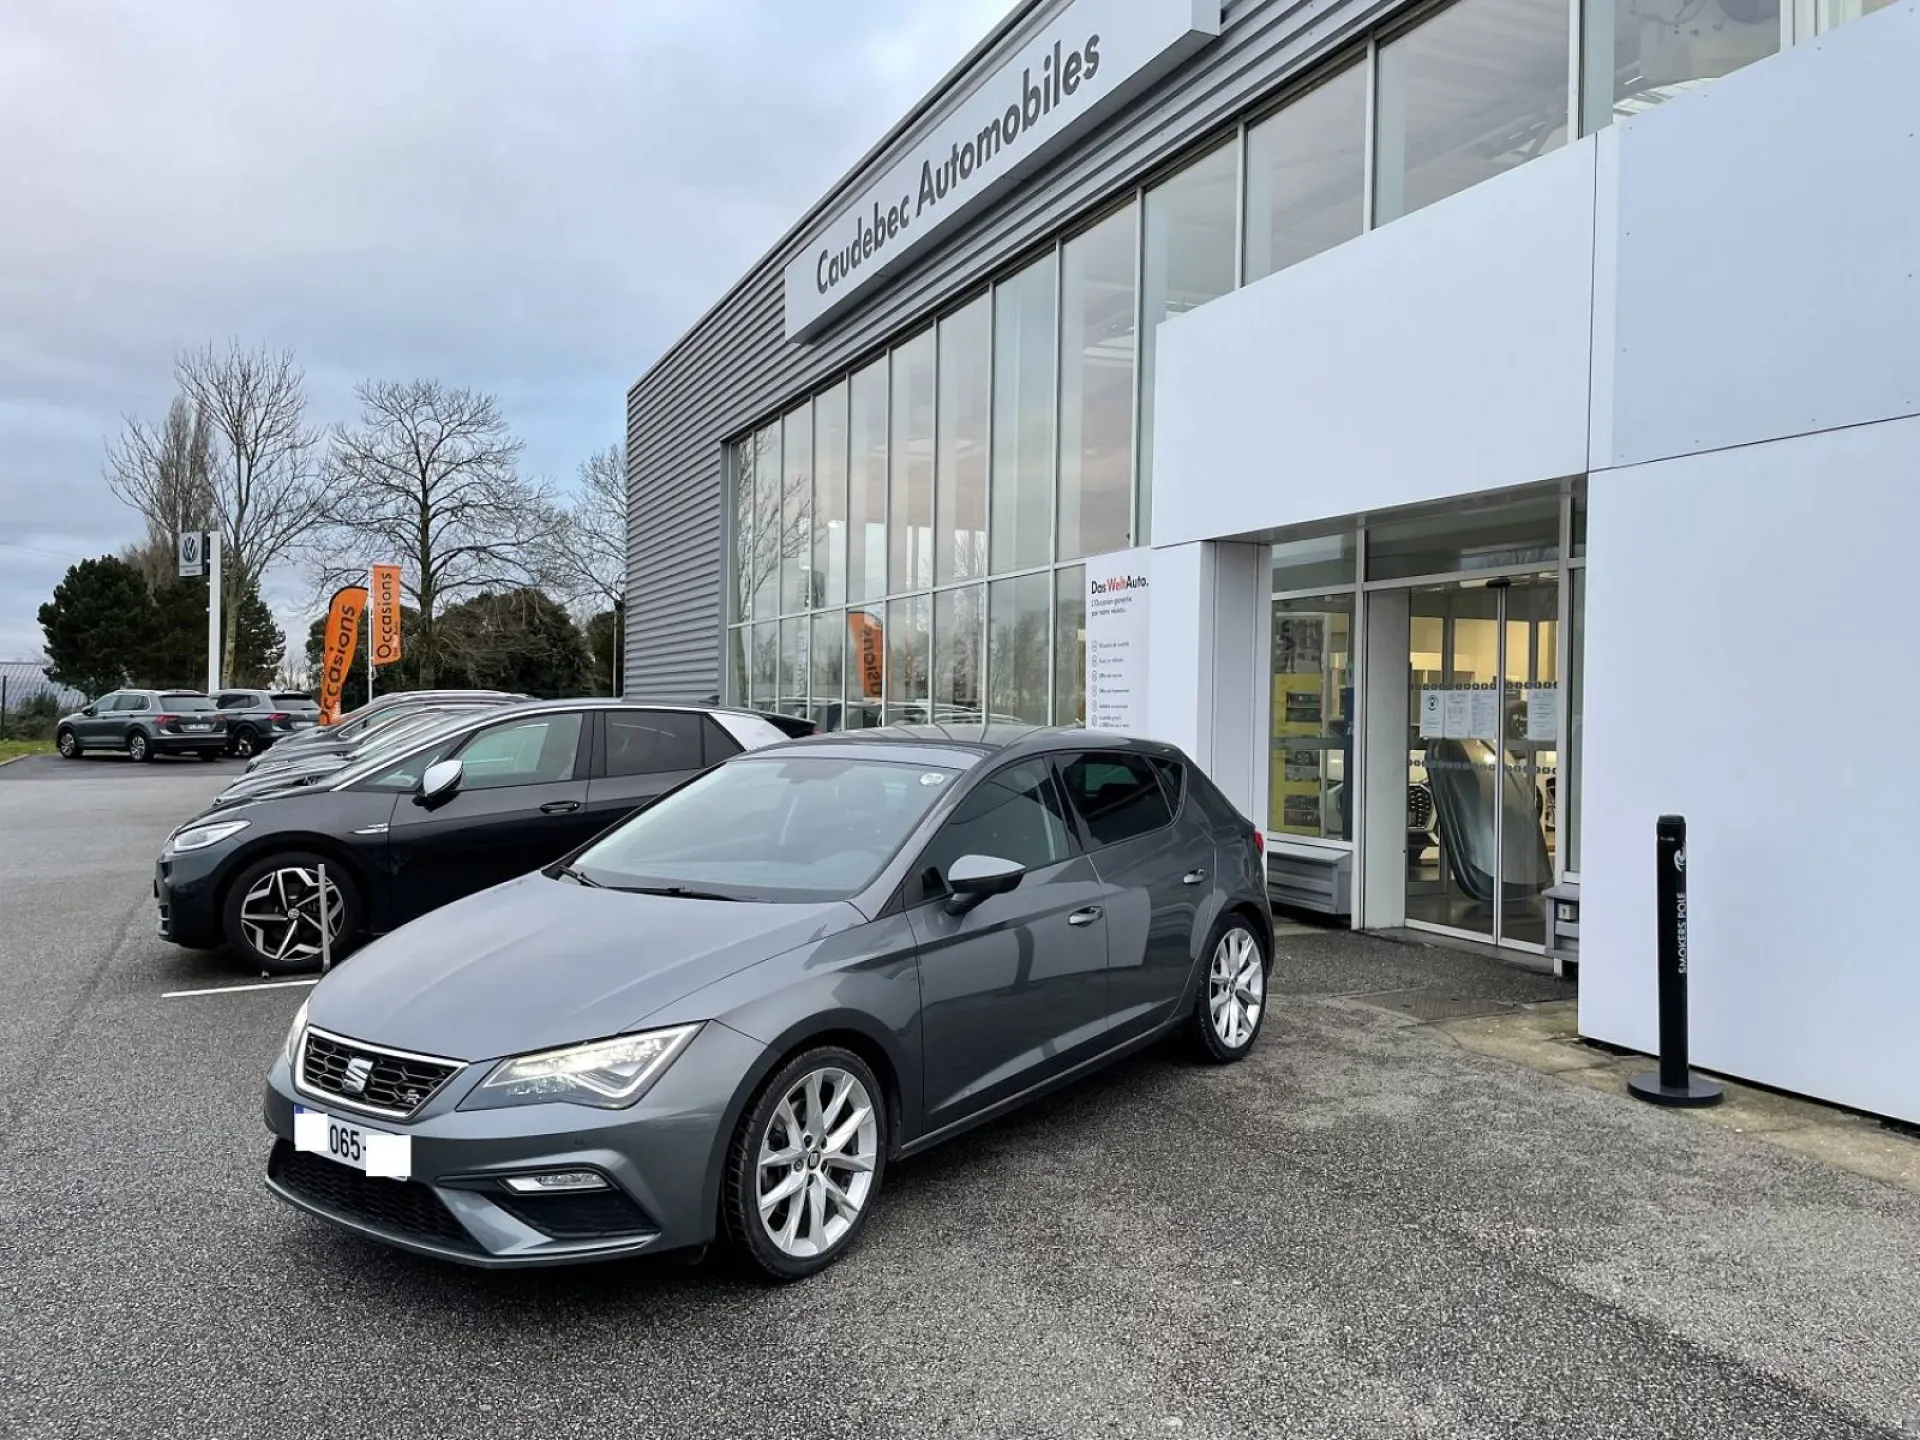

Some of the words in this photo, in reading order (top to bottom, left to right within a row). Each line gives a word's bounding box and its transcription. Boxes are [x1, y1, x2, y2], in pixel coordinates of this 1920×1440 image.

[816, 192, 910, 294] Caudebec
[915, 32, 1101, 218] Automobiles
[376, 572, 393, 659] Occasions
[1091, 580, 1107, 595] Das
